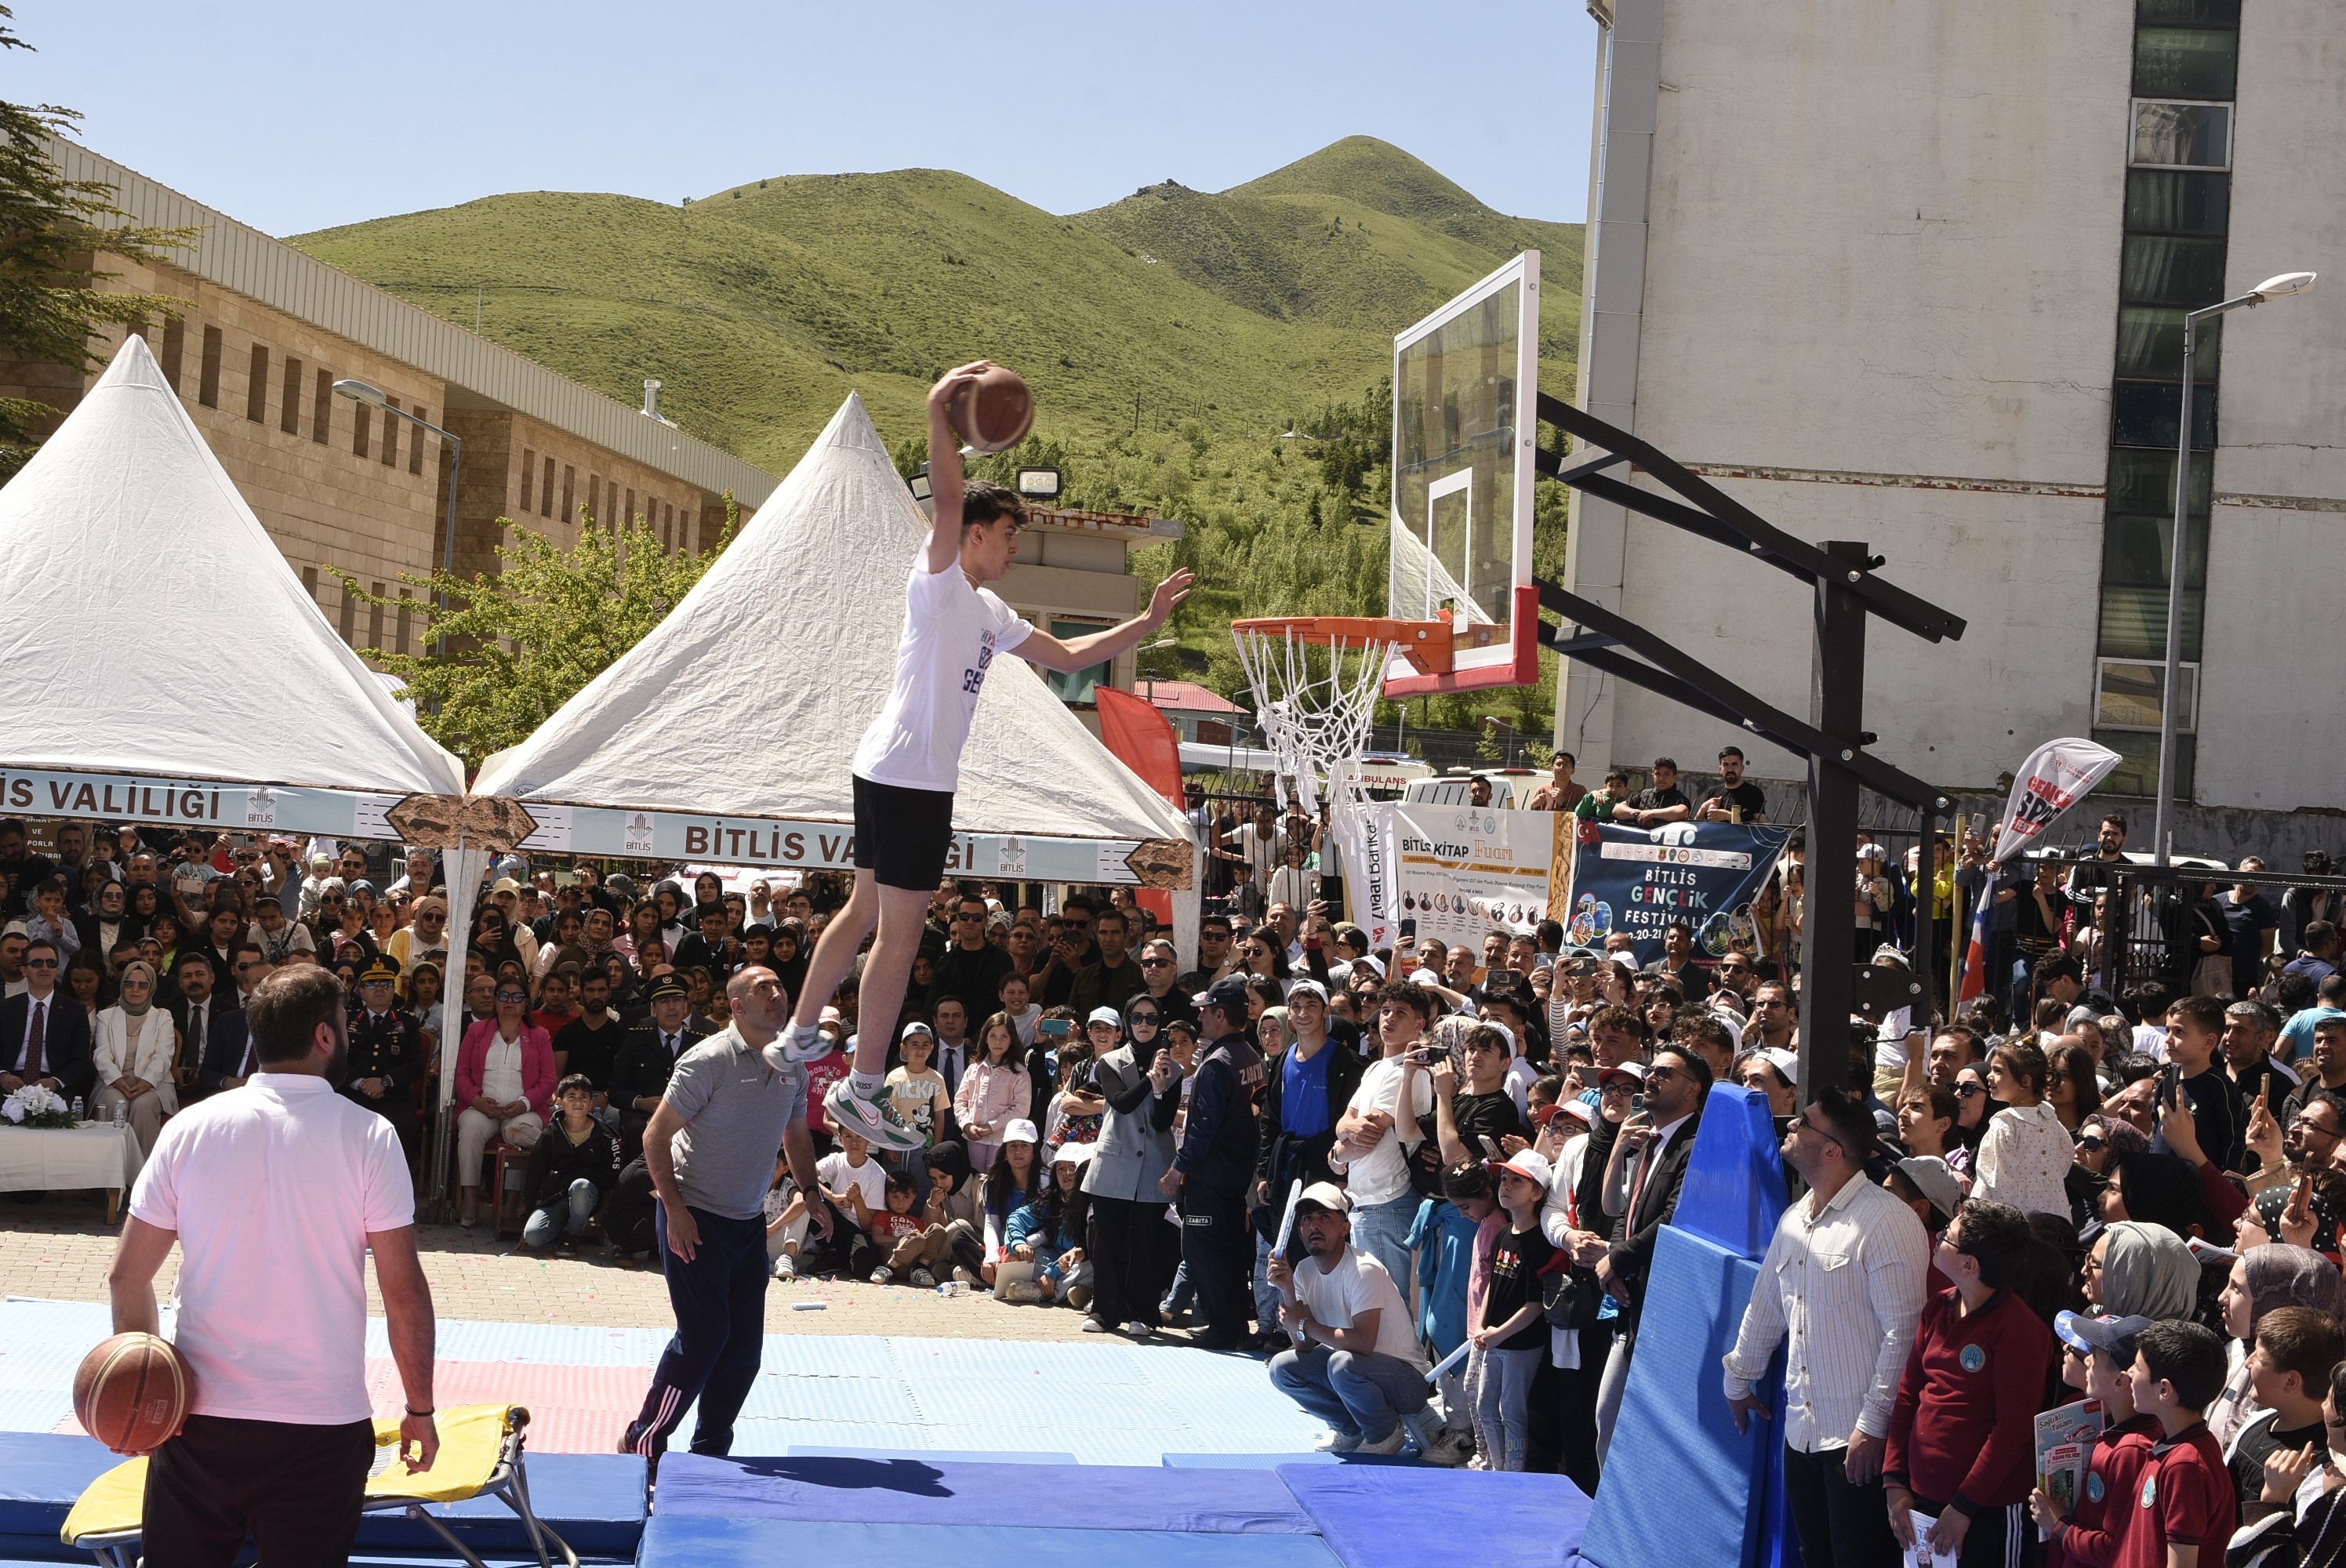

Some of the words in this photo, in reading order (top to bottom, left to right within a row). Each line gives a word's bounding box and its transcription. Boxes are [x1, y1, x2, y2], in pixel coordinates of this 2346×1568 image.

[1348, 775, 1407, 785] ABULANS
[49, 779, 220, 820] VALİLİĞİ
[248, 812, 274, 823] BİTLİS
[626, 840, 651, 851] BİTLİS
[685, 820, 805, 861] BİTLİS
[1433, 841, 1469, 858] KİTAP
[1473, 839, 1514, 861] Fuarı
[1000, 862, 1024, 873] BİTLİS
[1645, 866, 1697, 886] BİTLİS
[808, 1065, 830, 1077] BORN
[832, 1066, 841, 1076] TO
[855, 1080, 873, 1090] BOSS
[2039, 1412, 2064, 1429] Sağlıklı
[2051, 1418, 2073, 1432] Yaşam
